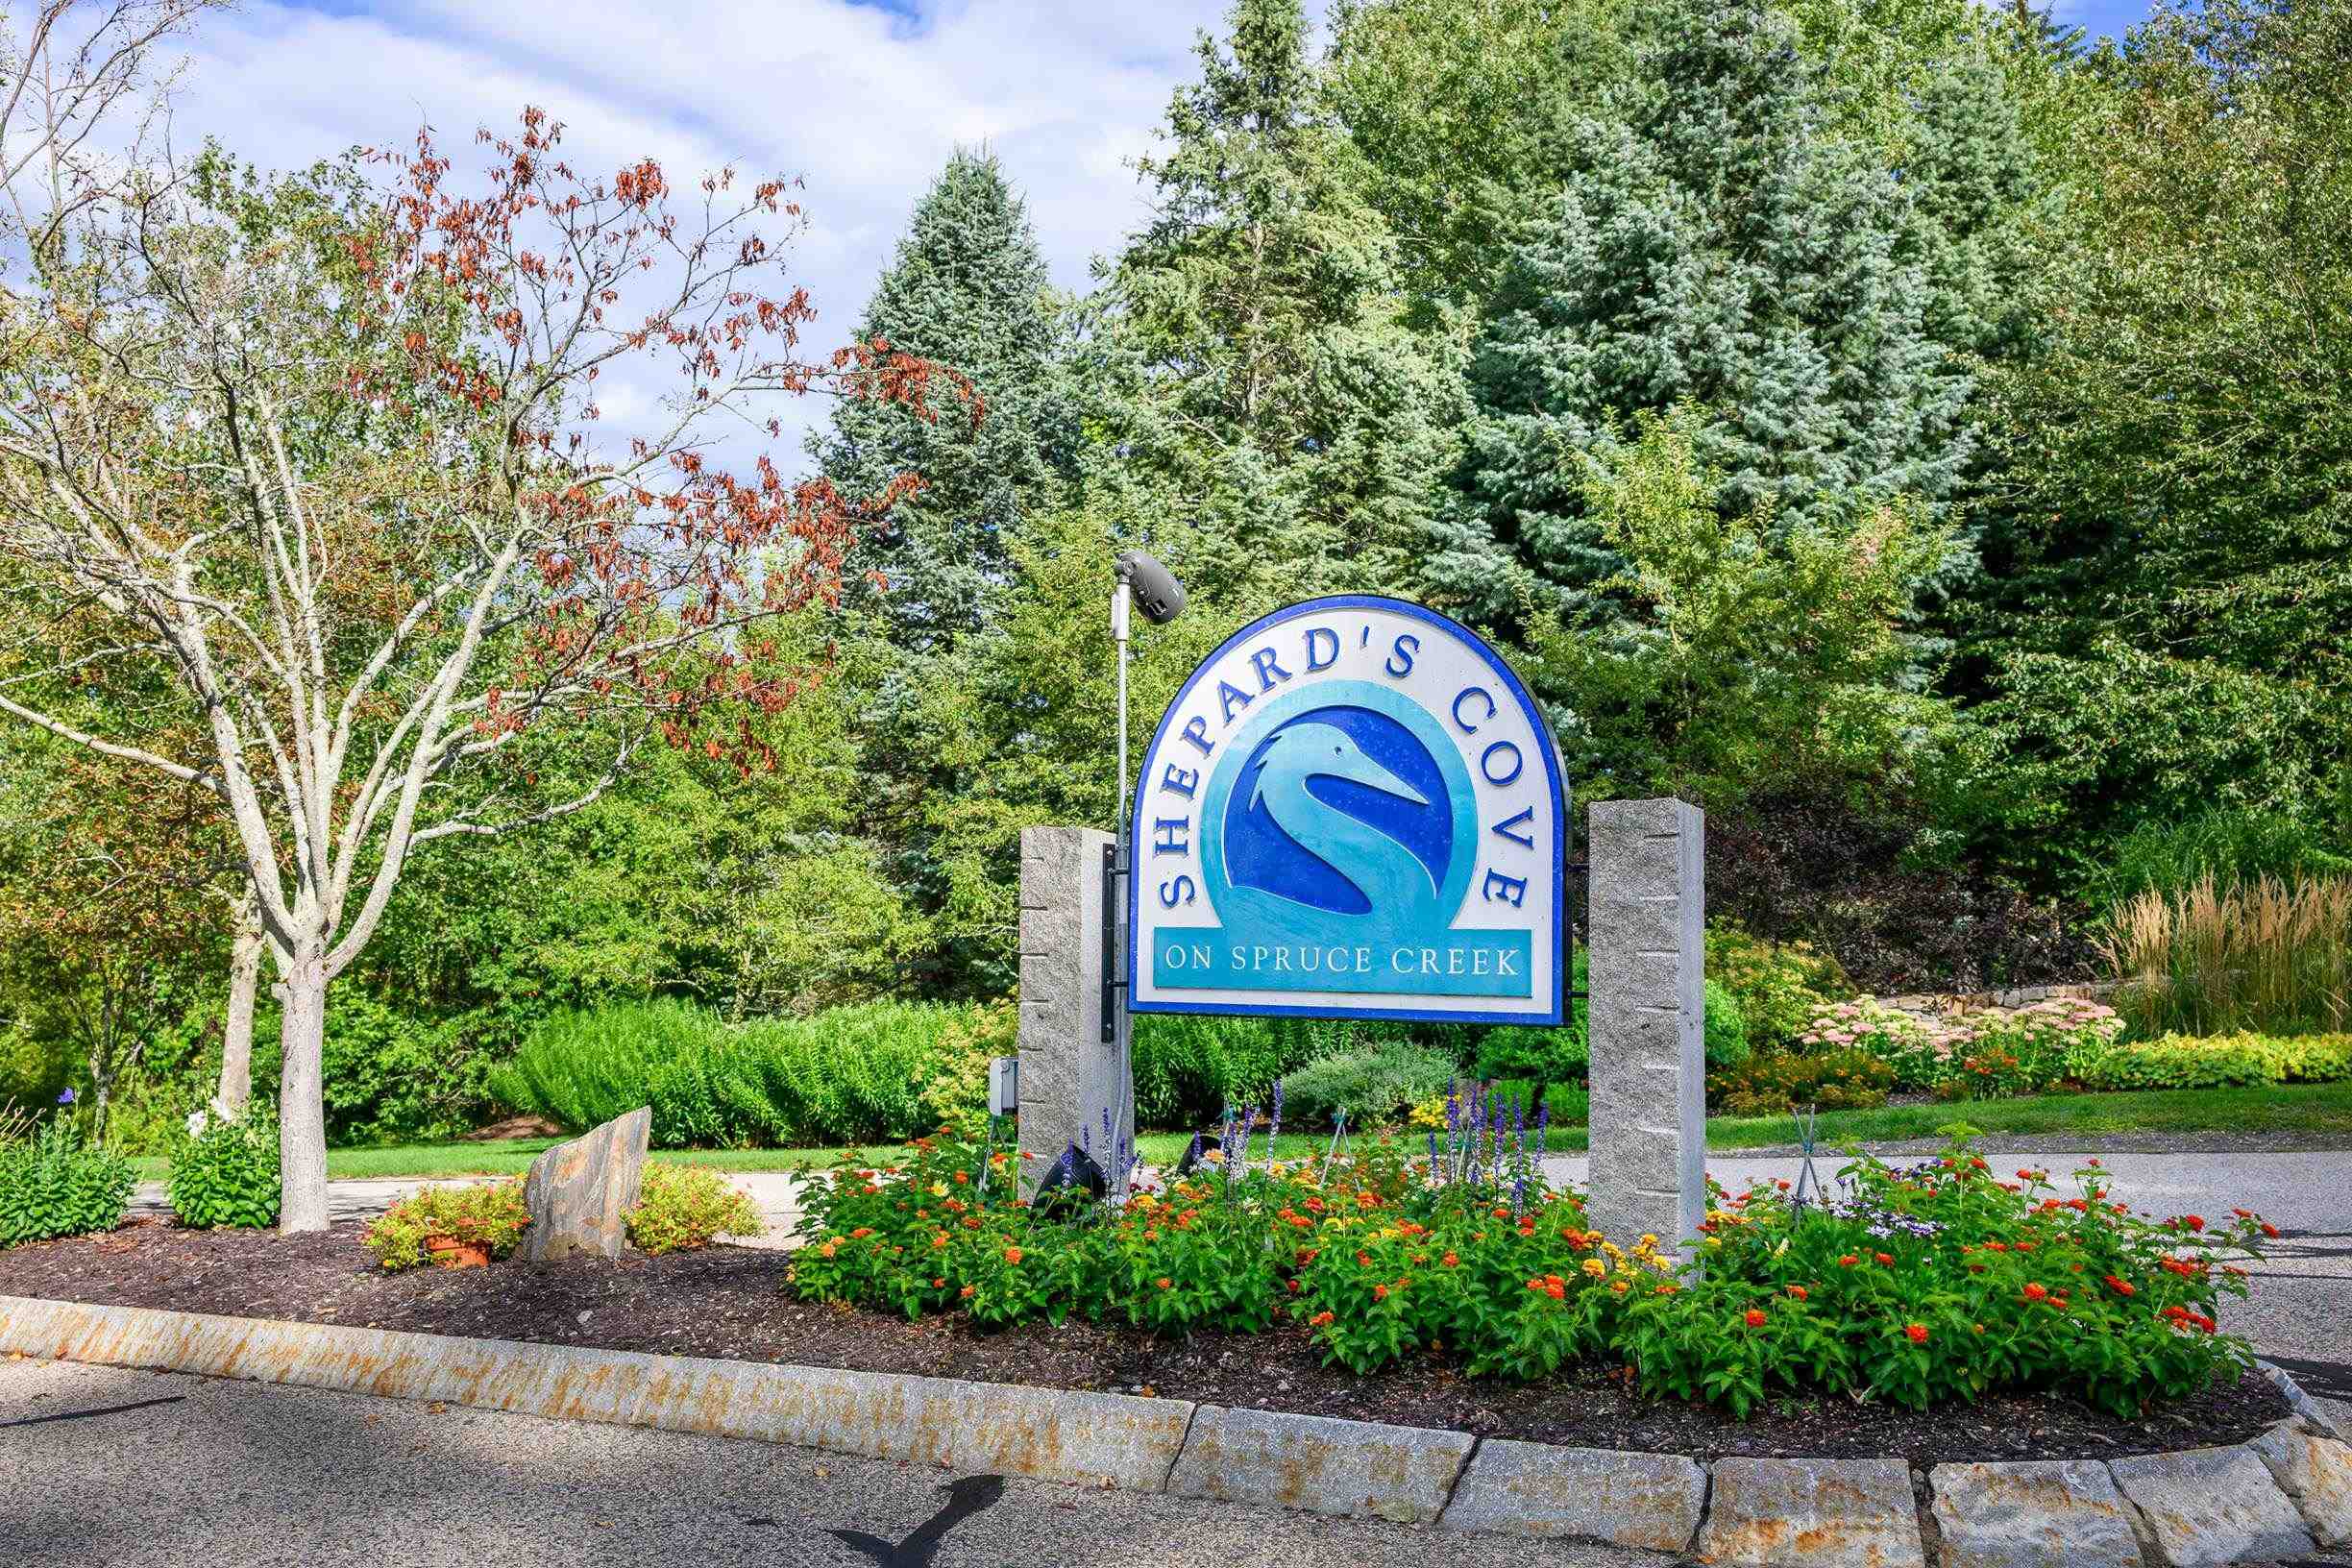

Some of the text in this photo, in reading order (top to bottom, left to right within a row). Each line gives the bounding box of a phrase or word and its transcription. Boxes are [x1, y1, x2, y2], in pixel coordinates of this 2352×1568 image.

[1153, 626, 1533, 908] SHEPARD'S COVE
[1165, 944, 1520, 975] ON SPRUCE CREEK
